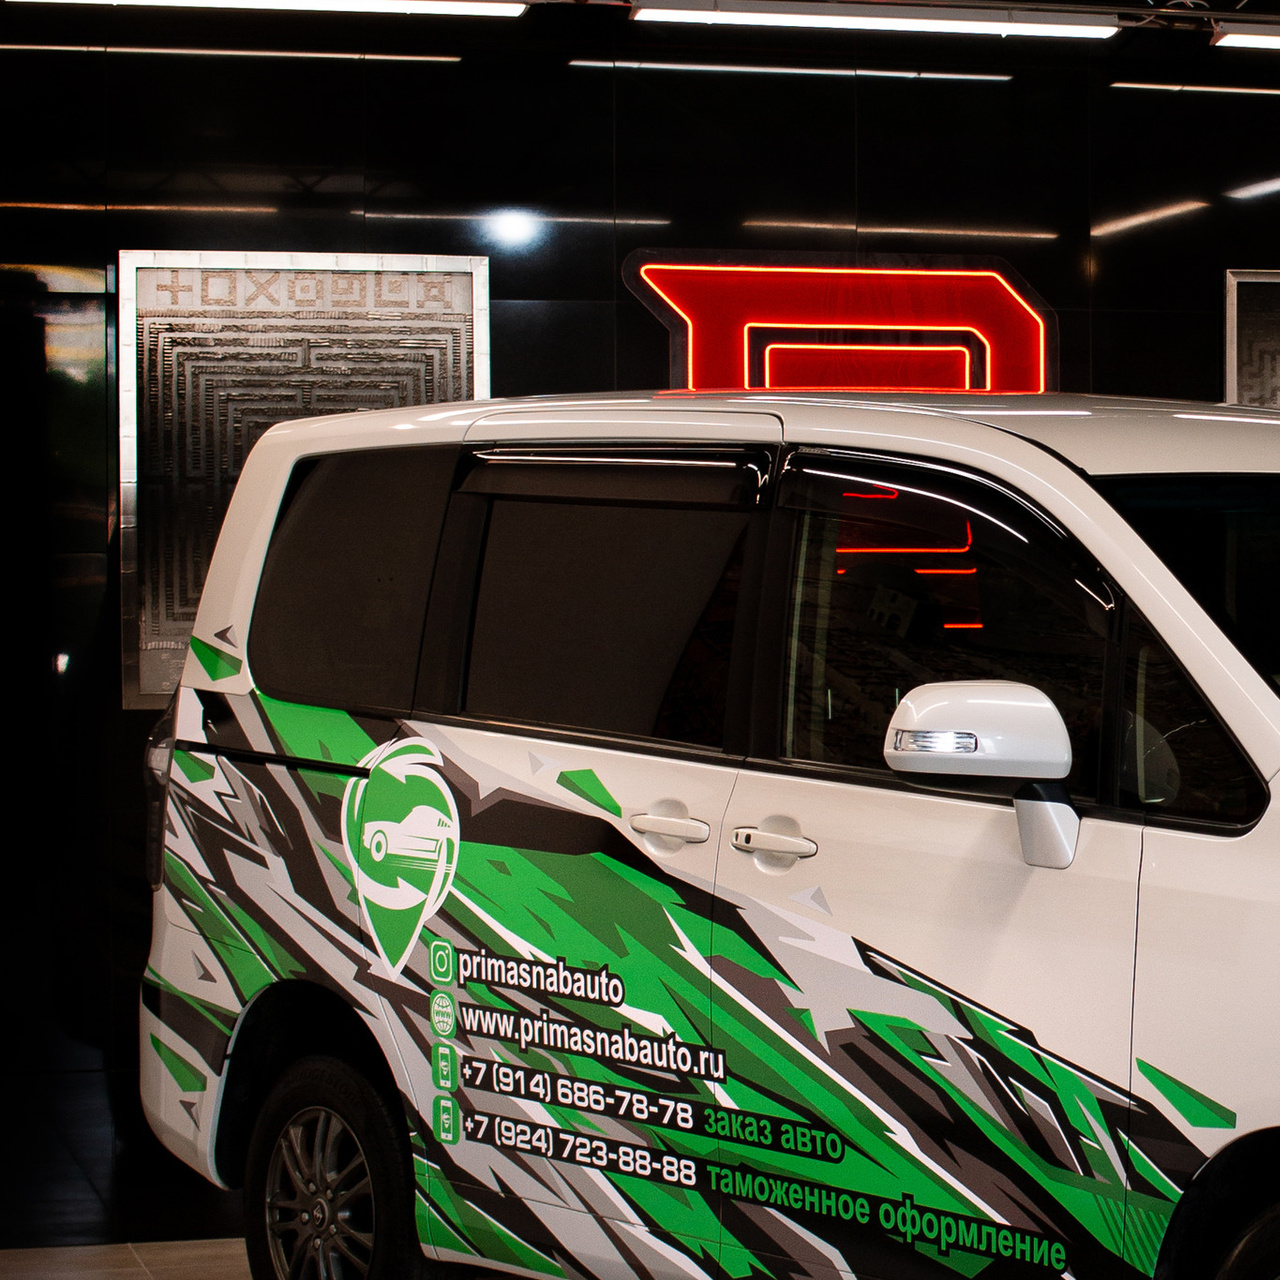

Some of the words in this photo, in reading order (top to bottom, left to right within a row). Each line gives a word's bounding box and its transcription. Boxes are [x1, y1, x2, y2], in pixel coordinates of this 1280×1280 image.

[458, 949, 624, 1004] primasnabauto
[461, 1006, 725, 1080] www.primasnabauto.ru
[462, 1060, 487, 1086] +7
[492, 1065, 552, 1103] (914)
[556, 1080, 694, 1130] 686-78-78
[464, 1115, 490, 1140] +7
[494, 1119, 554, 1158] (924)
[558, 1134, 697, 1187] 723-88-88
[703, 1107, 773, 1146] заказ
[781, 1124, 842, 1160] авто
[706, 1164, 871, 1225] таможенное
[878, 1198, 1066, 1270] оформление
